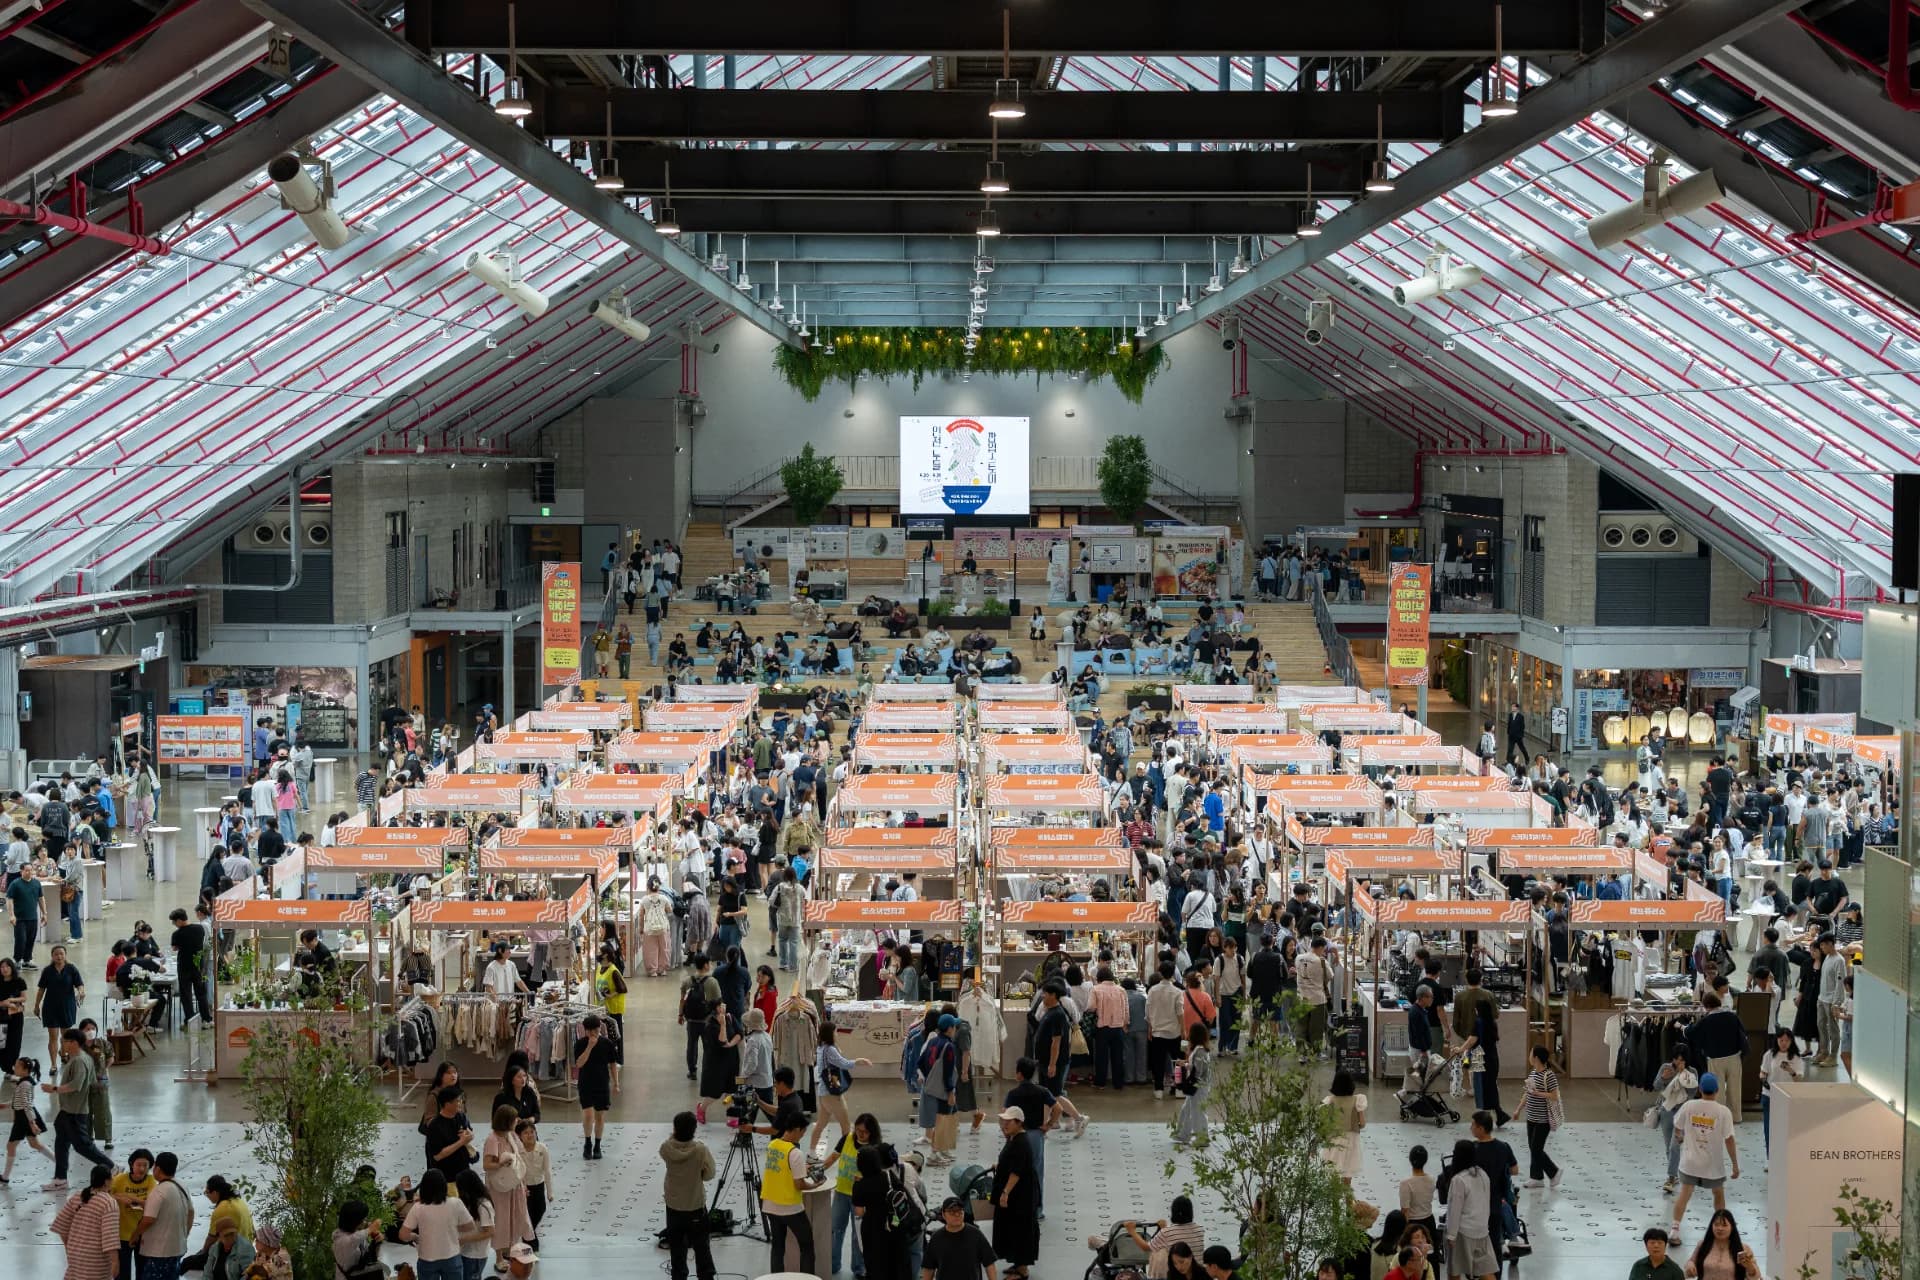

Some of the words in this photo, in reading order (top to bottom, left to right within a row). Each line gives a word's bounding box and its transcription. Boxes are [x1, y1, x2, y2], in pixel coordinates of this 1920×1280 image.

[1416, 907, 1449, 915] CAMPER
[1450, 907, 1493, 915] STANDARD
[1809, 1150, 1840, 1160] BEAN
[1843, 1150, 1901, 1160] BROTHERS
